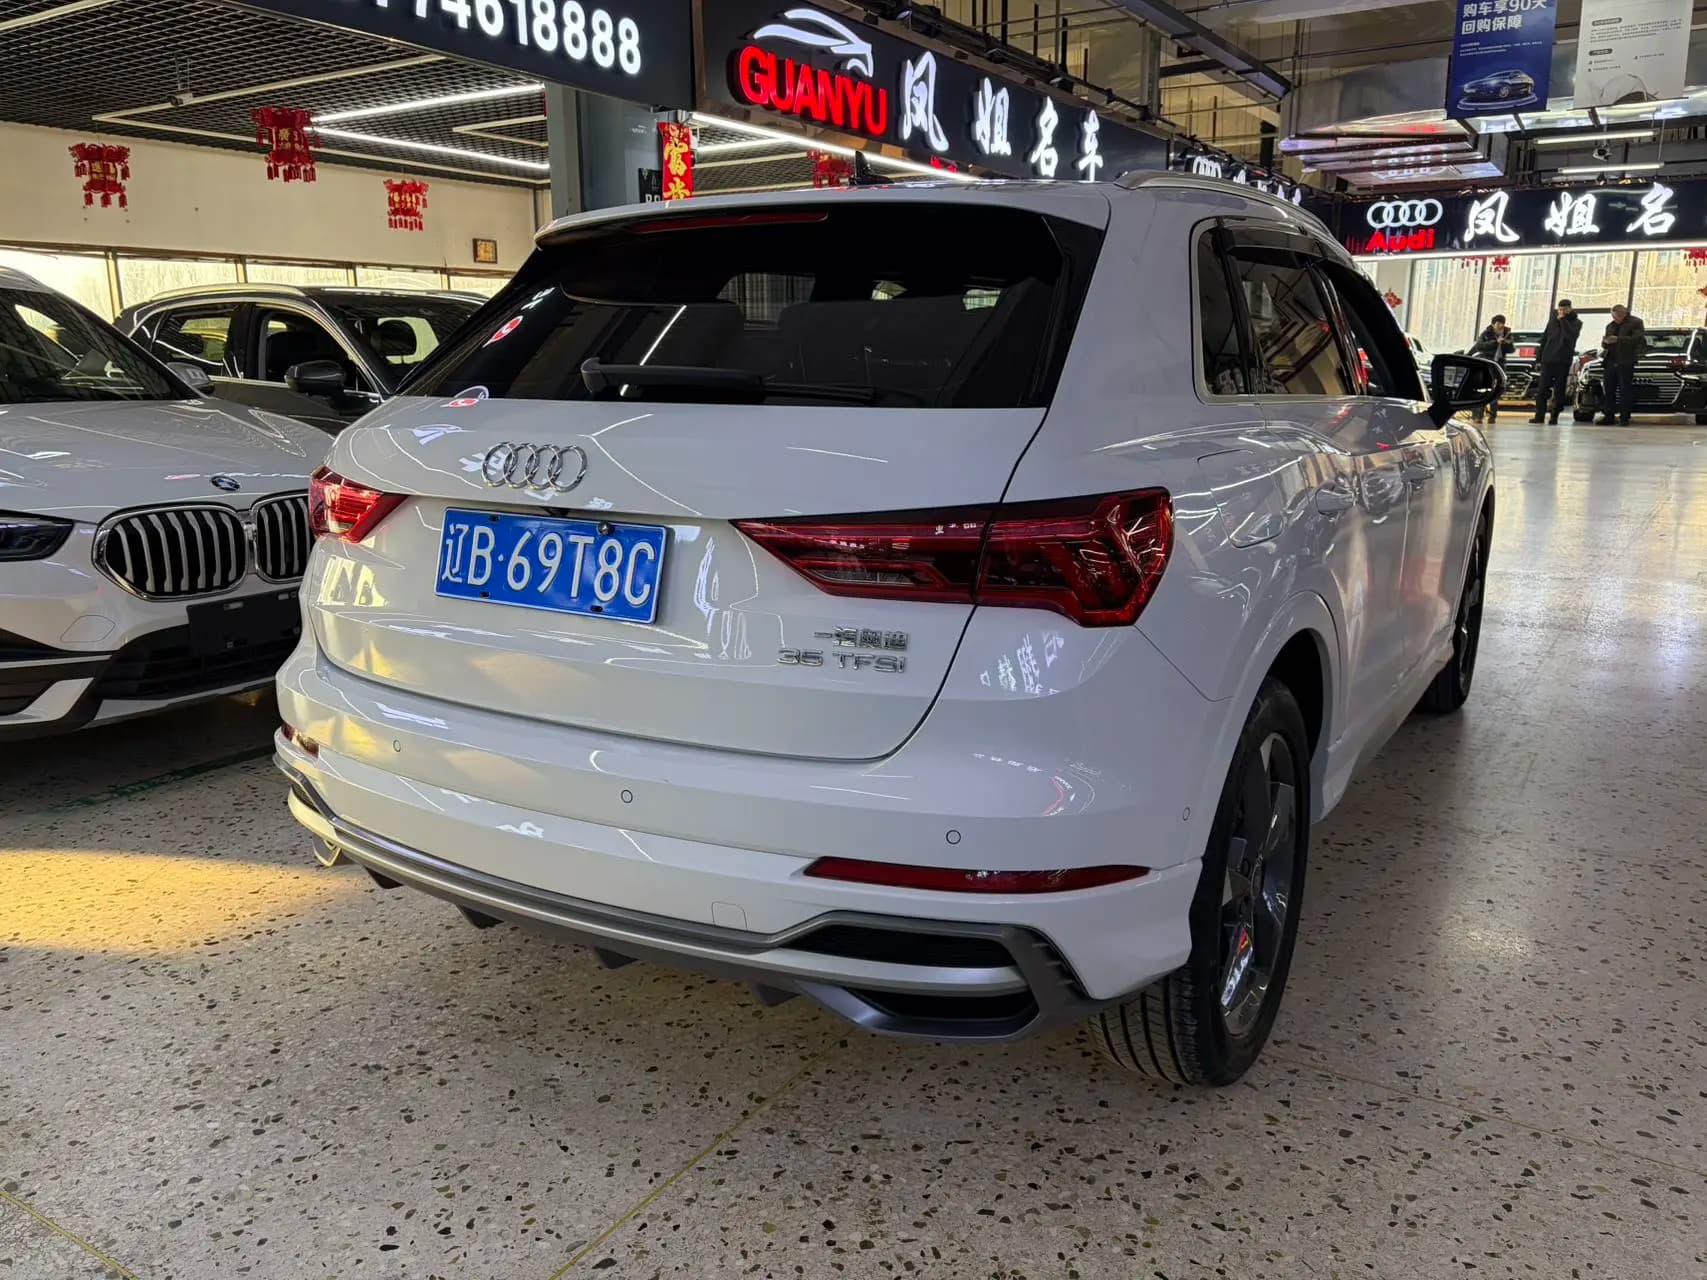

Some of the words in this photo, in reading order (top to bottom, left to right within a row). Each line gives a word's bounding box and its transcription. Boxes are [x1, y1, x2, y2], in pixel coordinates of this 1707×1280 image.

[1462, 15, 1523, 35] 回购保障
[739, 46, 888, 136] GUANYU
[1366, 229, 1436, 252] Audi
[777, 648, 823, 666] 35
[832, 652, 906, 673] TFSI
